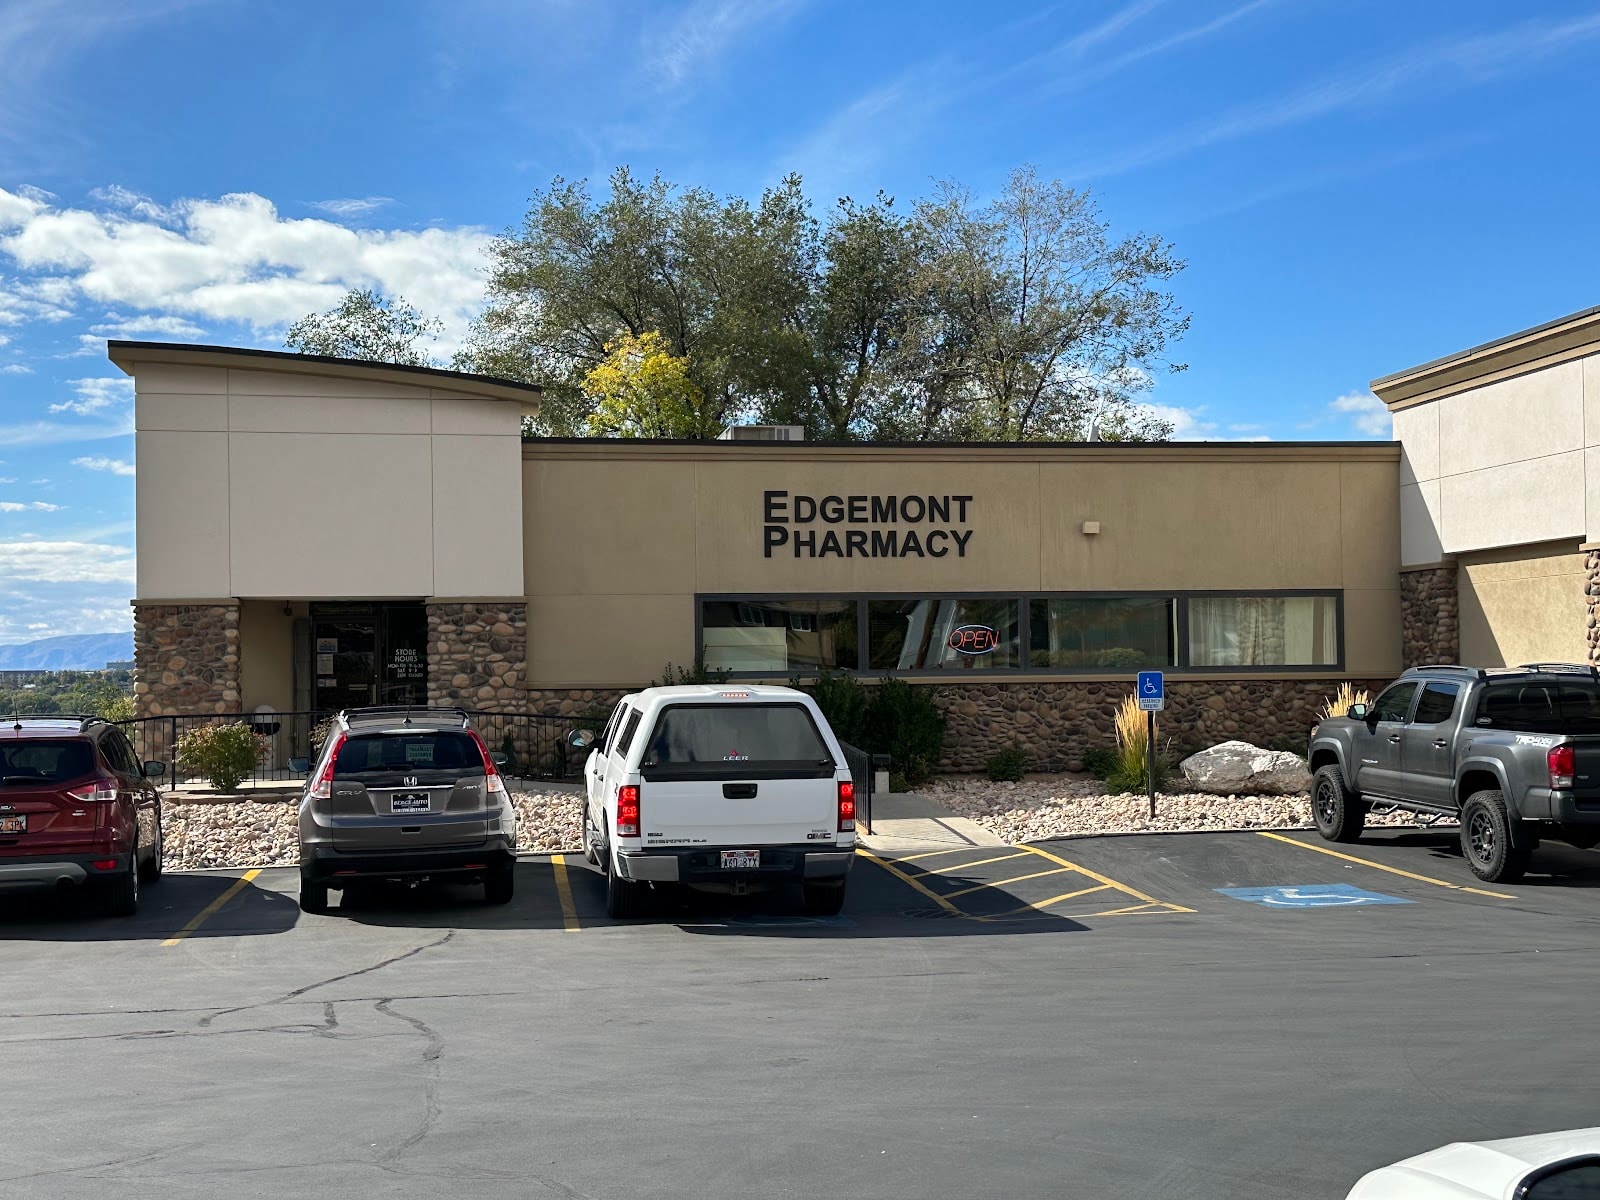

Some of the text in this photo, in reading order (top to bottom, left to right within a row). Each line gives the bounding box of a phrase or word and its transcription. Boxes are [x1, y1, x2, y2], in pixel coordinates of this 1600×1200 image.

[763, 490, 973, 523] EDGEMONT
[763, 525, 973, 558] PHARMACY
[950, 630, 999, 649] OPEN
